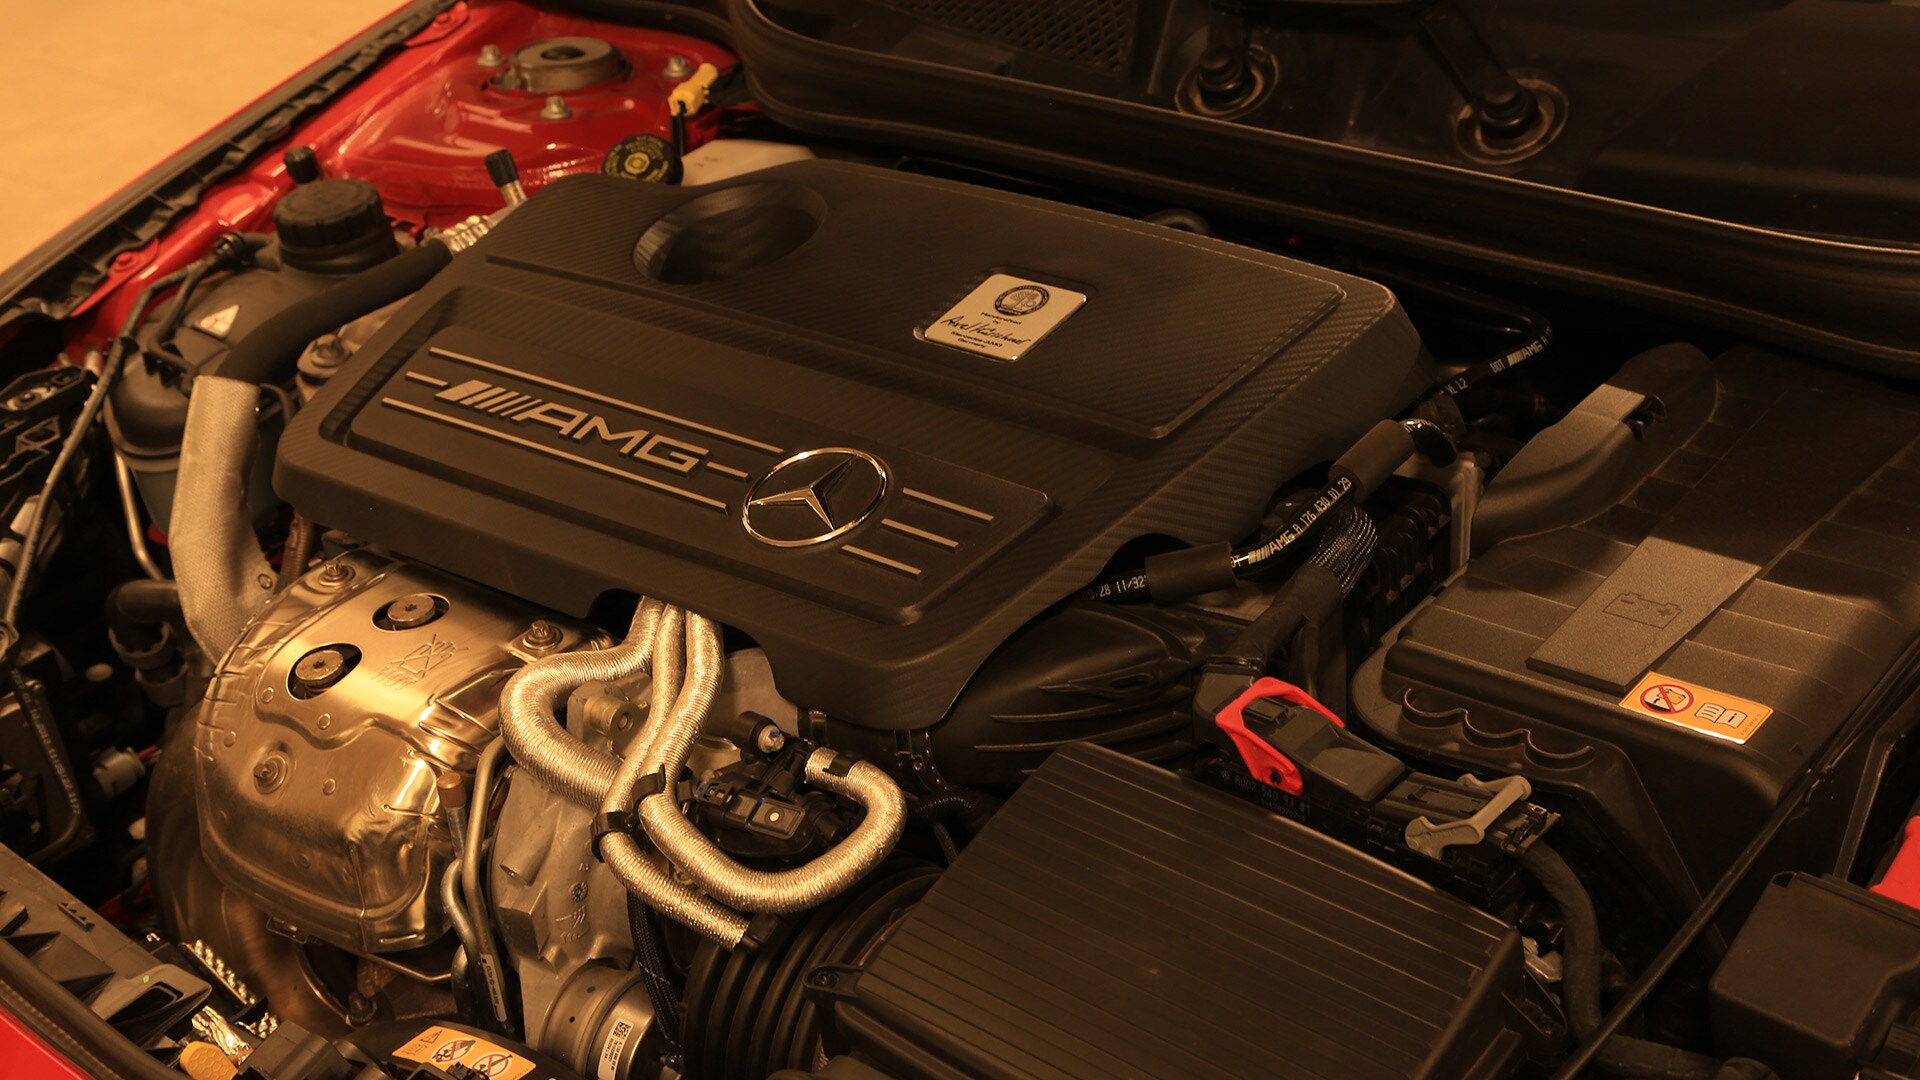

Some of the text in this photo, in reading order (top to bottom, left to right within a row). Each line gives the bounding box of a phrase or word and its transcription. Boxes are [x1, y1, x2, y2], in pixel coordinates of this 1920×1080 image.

[510, 402, 710, 473] AMG
[1300, 510, 1317, 527] 176
[1314, 496, 1331, 513] 430
[1327, 487, 1341, 500] 01
[1337, 476, 1352, 491] 29
